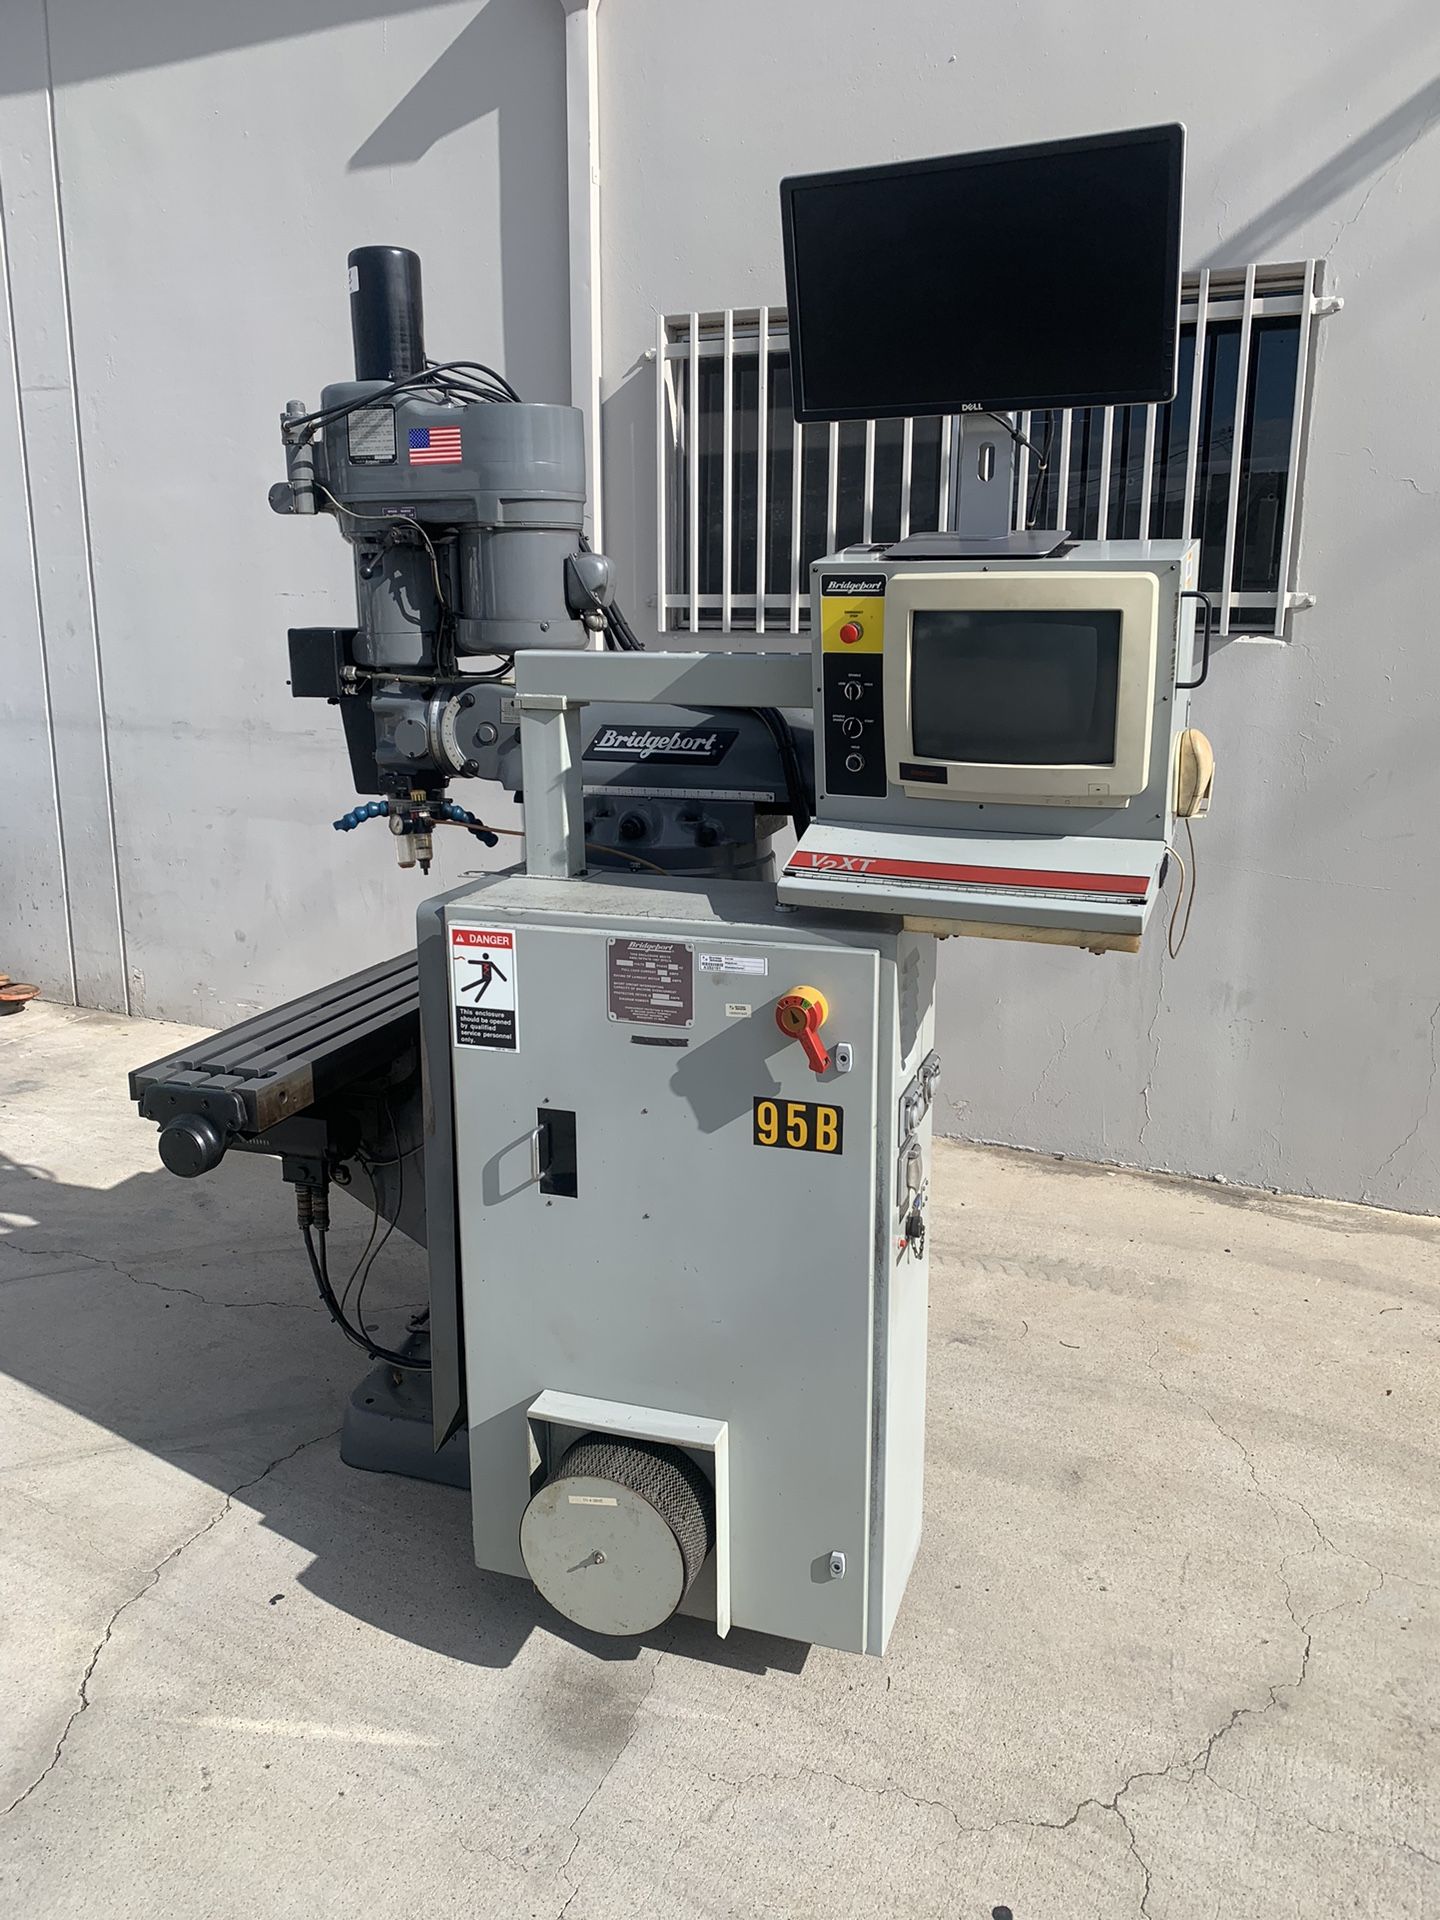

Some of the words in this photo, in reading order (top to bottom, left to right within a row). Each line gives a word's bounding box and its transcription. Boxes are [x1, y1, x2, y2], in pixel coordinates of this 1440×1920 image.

[961, 402, 983, 411] DELL
[826, 580, 882, 594] Bridgeport
[596, 729, 717, 759] Bridgeport
[469, 934, 510, 946] DANGER
[628, 941, 674, 953] Bridgeport
[460, 1008, 473, 1016] This
[475, 1010, 505, 1018] enclosure
[460, 1015, 480, 1023] should
[490, 1018, 512, 1027] opened
[460, 1022, 468, 1030] by
[470, 1024, 497, 1032] qualified
[460, 1030, 481, 1038] service
[483, 1032, 512, 1041] personnel
[461, 1037, 476, 1045] only.
[757, 1101, 838, 1152] 95B
